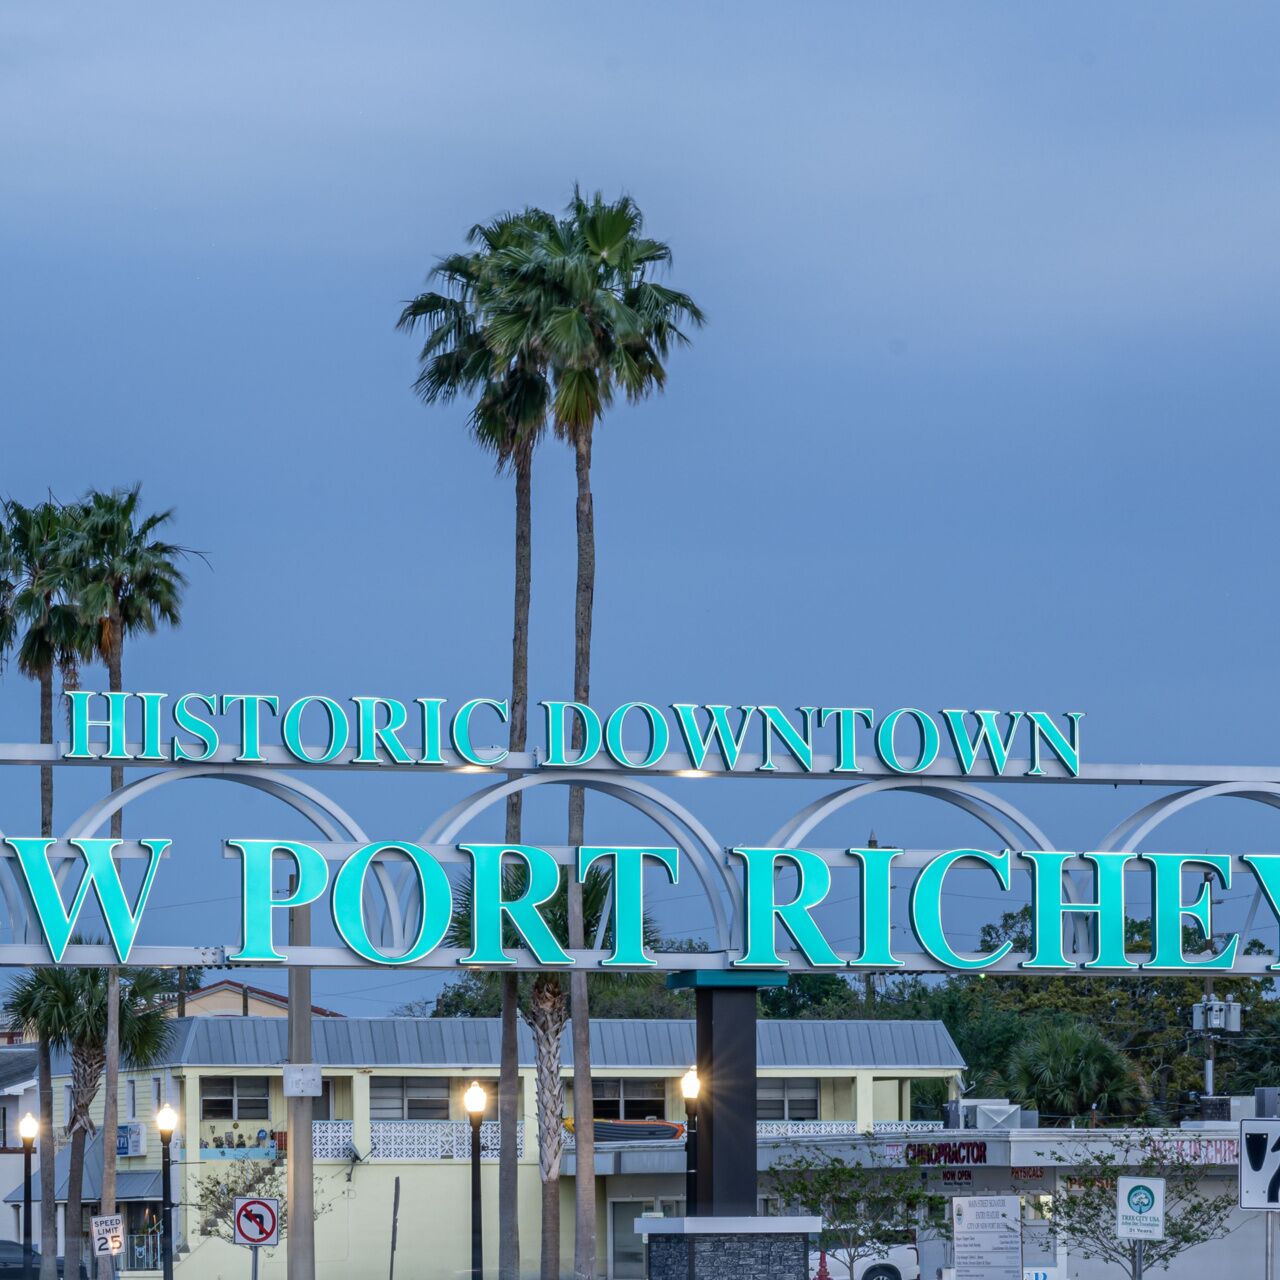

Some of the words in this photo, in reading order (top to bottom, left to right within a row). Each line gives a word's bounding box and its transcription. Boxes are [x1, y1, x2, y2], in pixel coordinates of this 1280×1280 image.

[64, 690, 509, 767] HISTORIC
[538, 700, 1085, 777] DOWNTOWN
[227, 838, 680, 966] PORT
[942, 1170, 956, 1181] NOW
[957, 1169, 972, 1181] OPEN
[1011, 1166, 1045, 1179] PHYSICALS
[94, 1219, 120, 1228] SPEED
[97, 1227, 118, 1236] LIMIT
[97, 1235, 122, 1252] 25
